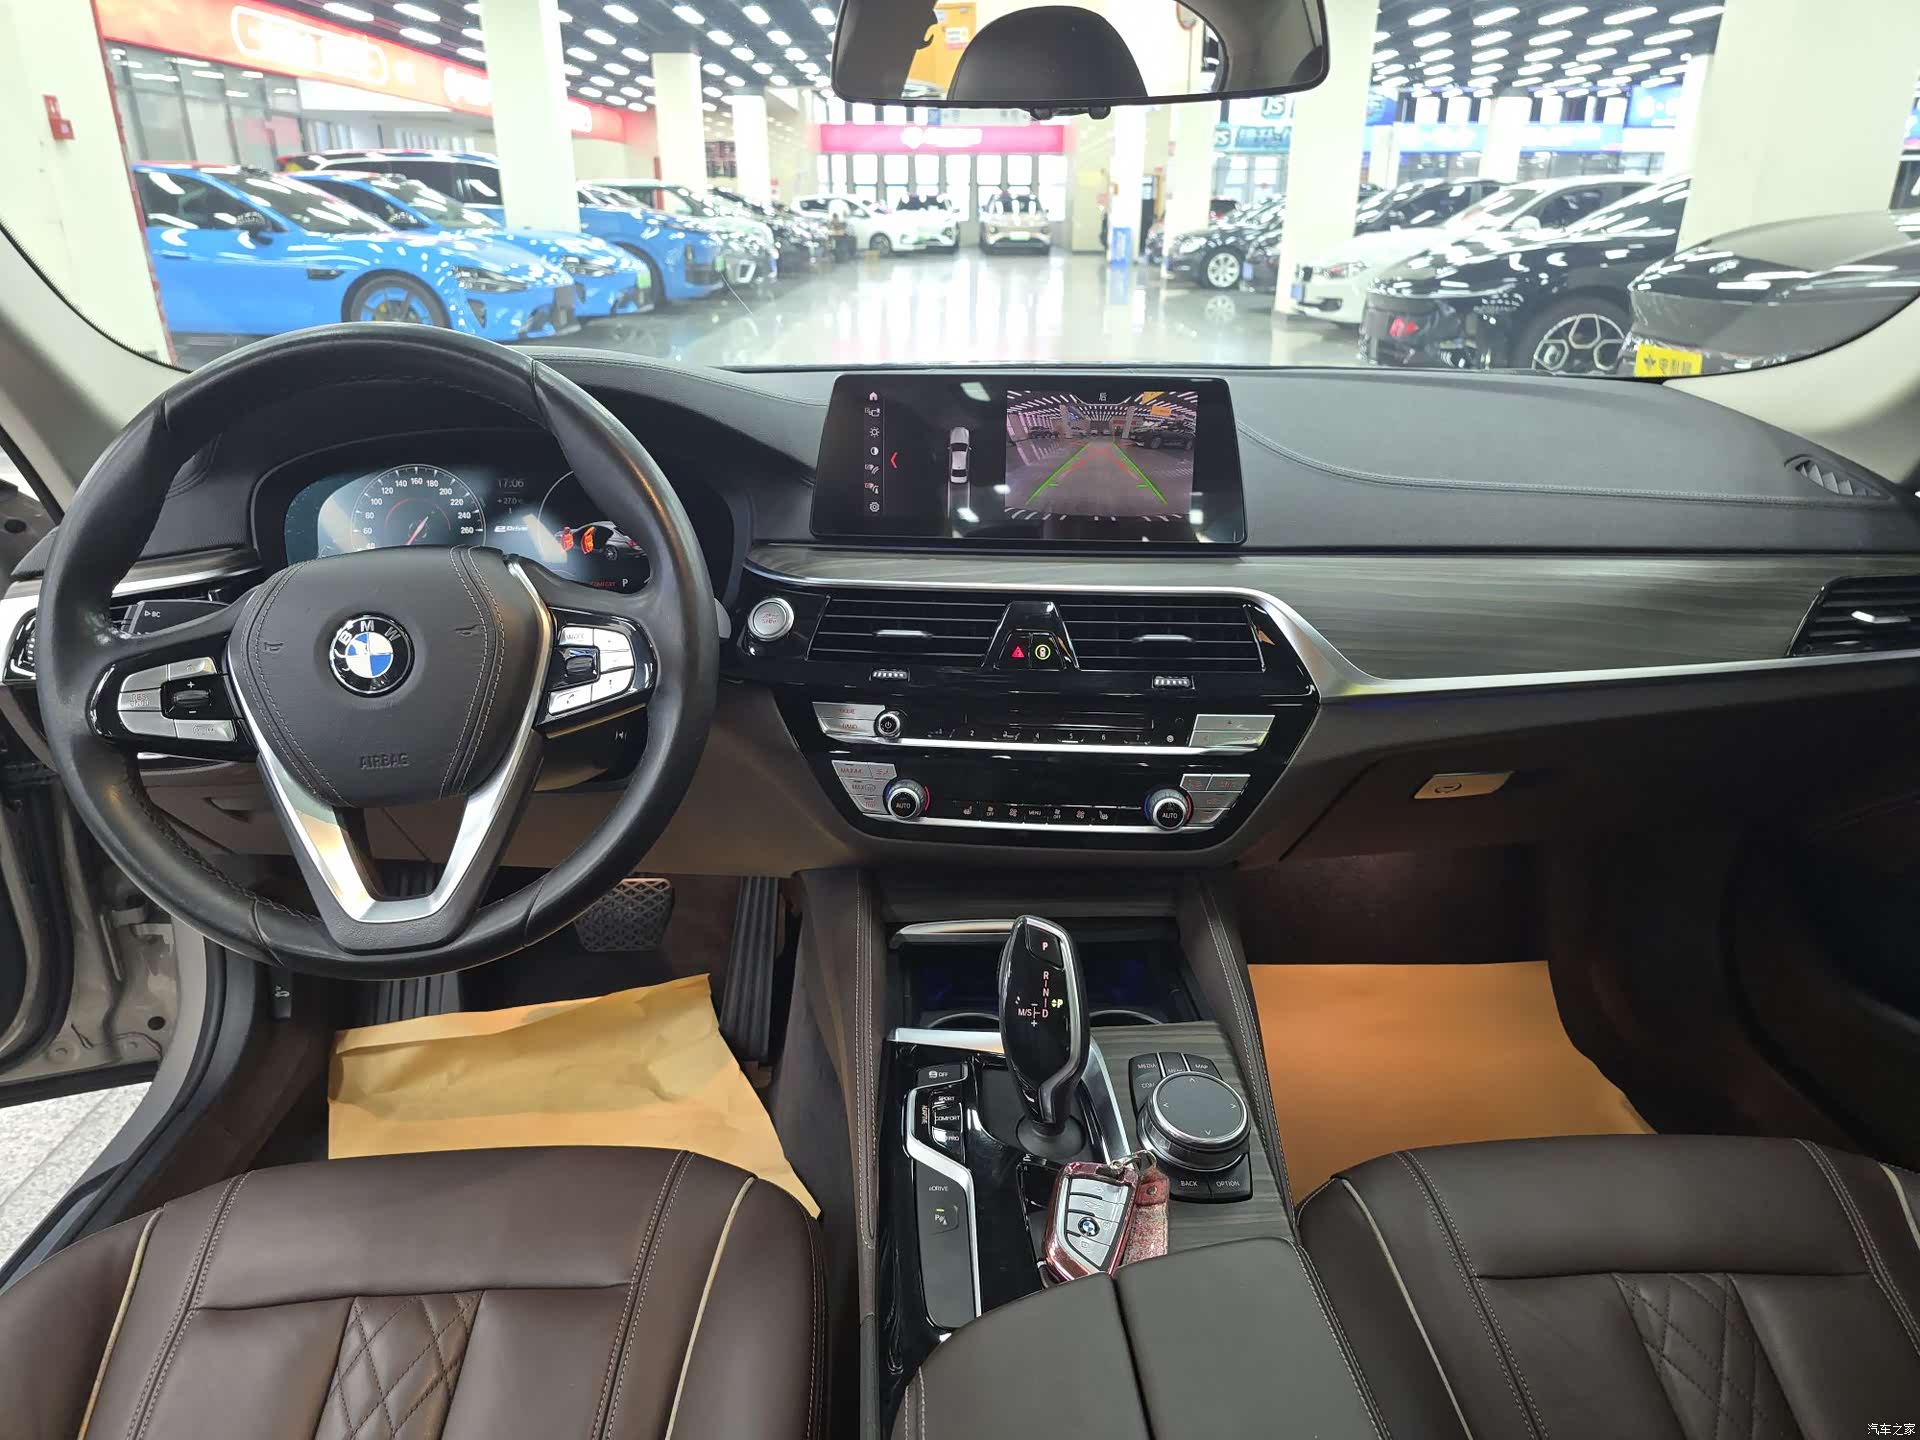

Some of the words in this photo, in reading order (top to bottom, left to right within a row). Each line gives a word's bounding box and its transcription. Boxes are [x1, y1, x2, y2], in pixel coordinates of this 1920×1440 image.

[411, 477, 423, 485] 160
[382, 487, 394, 495] 120
[370, 498, 383, 506] 100
[363, 527, 373, 535] 60
[622, 578, 629, 587] P
[339, 620, 401, 645] BMW
[360, 752, 410, 770] AIRBAG
[1042, 942, 1049, 951] P
[1043, 971, 1049, 980] R
[1042, 988, 1049, 997] N
[1018, 1008, 1032, 1017] M/S
[1042, 1009, 1049, 1018] D
